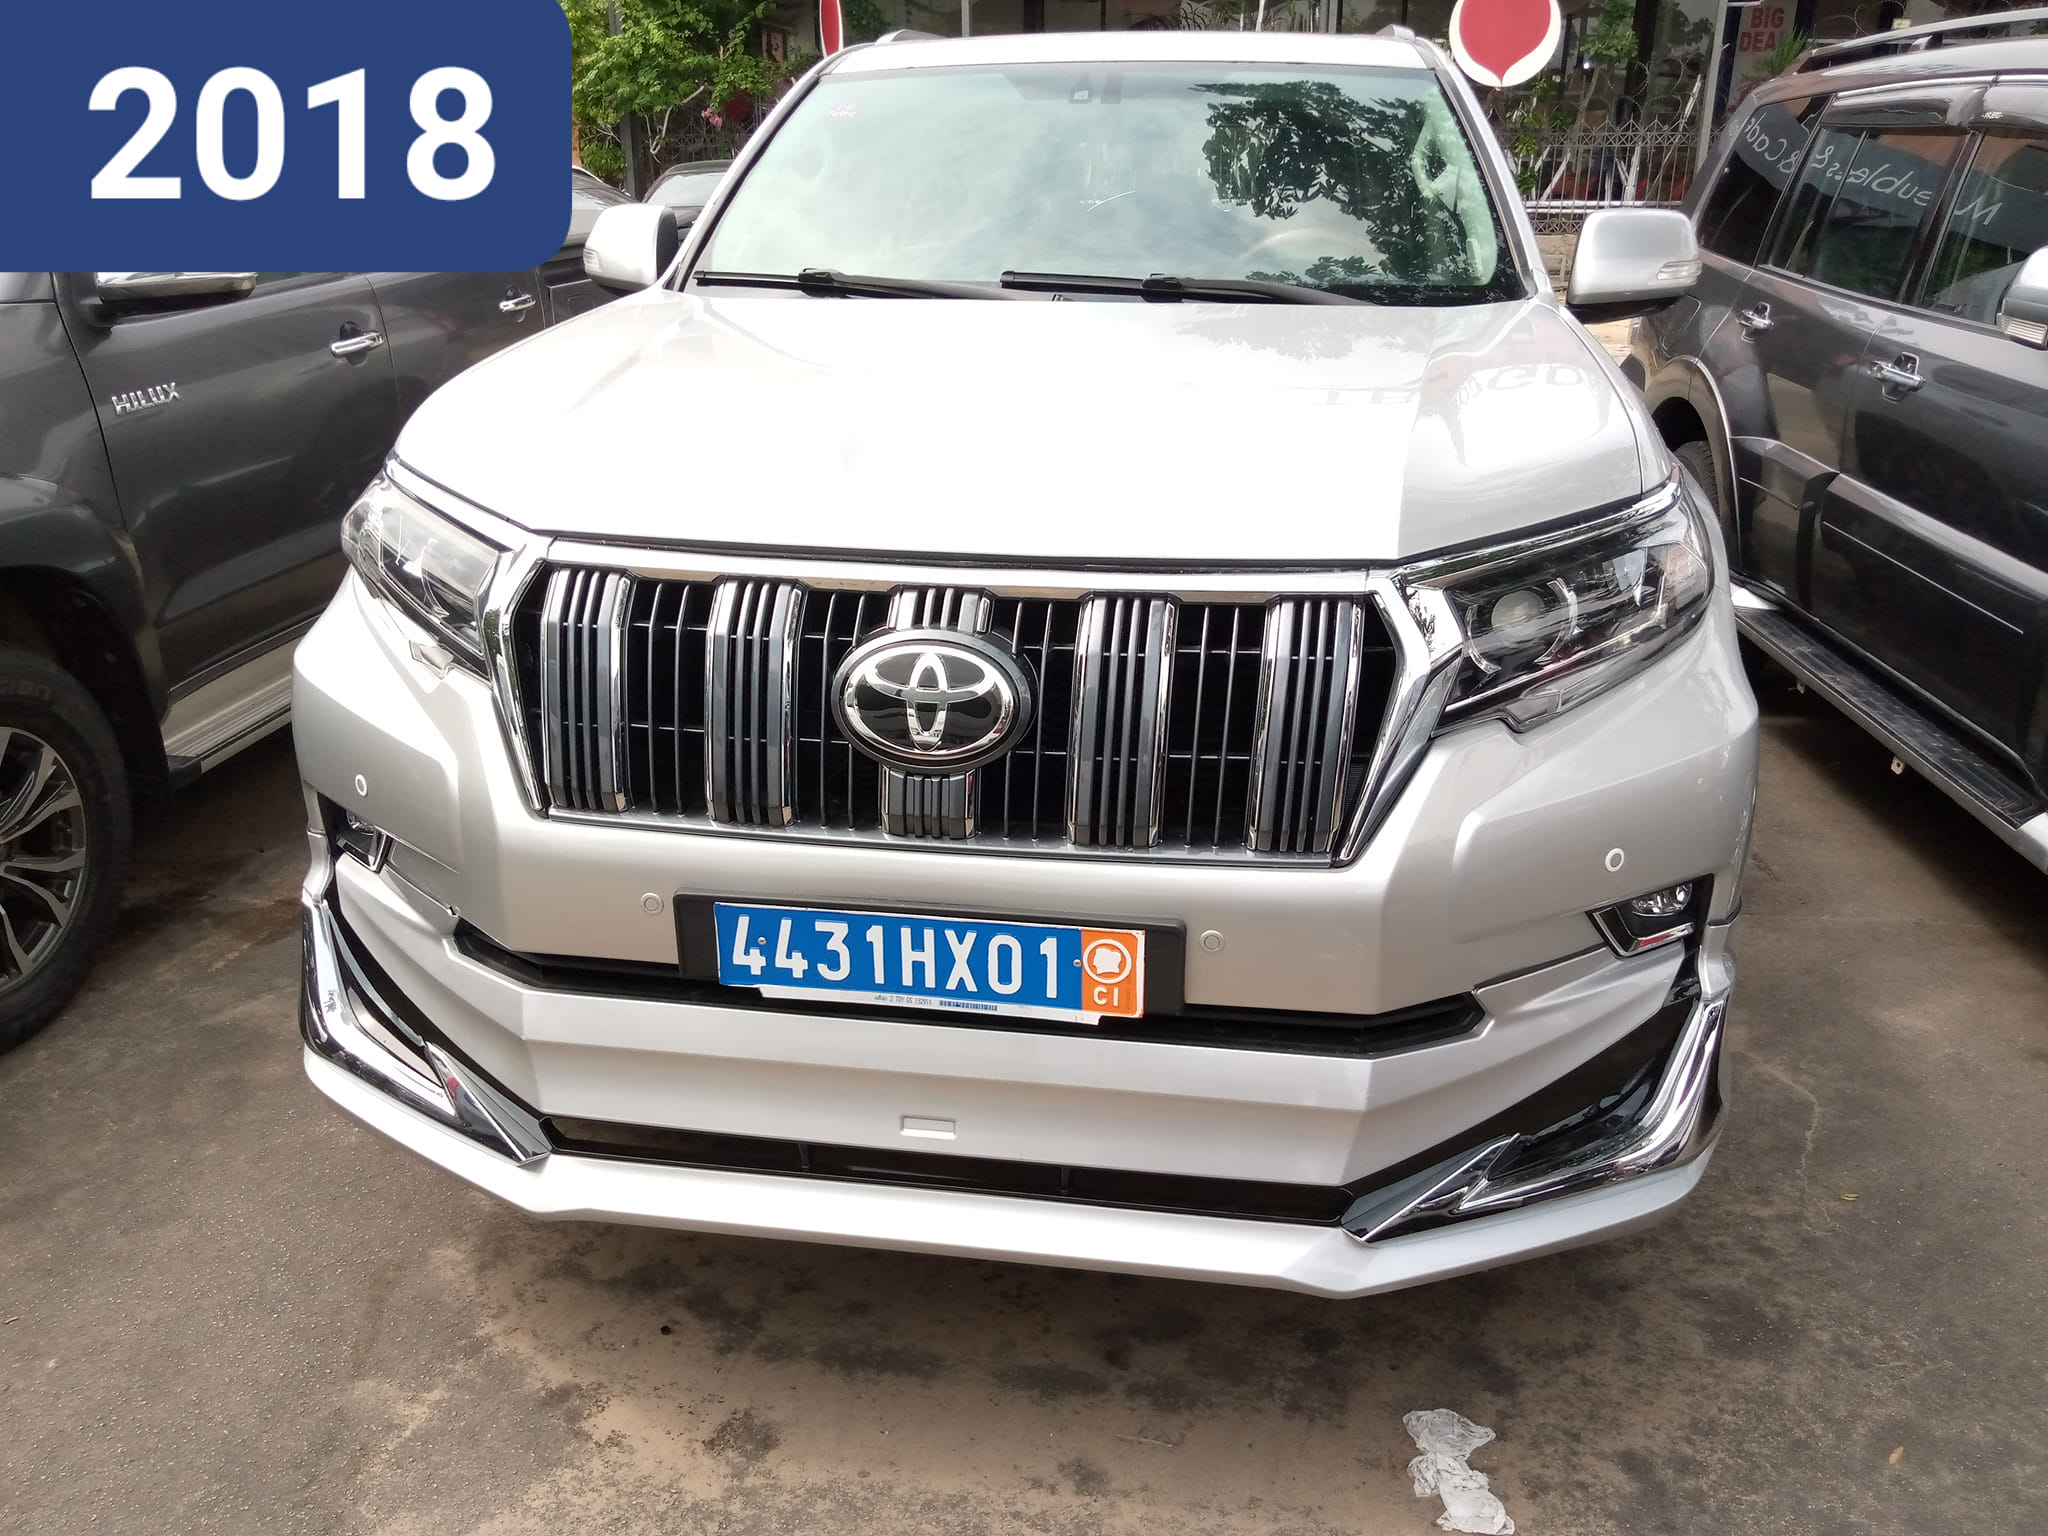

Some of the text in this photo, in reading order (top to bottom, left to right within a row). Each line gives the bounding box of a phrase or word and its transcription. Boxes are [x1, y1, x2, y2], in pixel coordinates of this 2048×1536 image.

[1750, 7, 1785, 29] BIG
[1738, 31, 1780, 52] DEA
[111, 381, 180, 416] HILUX
[732, 914, 1058, 999] 4431HX01
[1093, 986, 1119, 1007] CI
